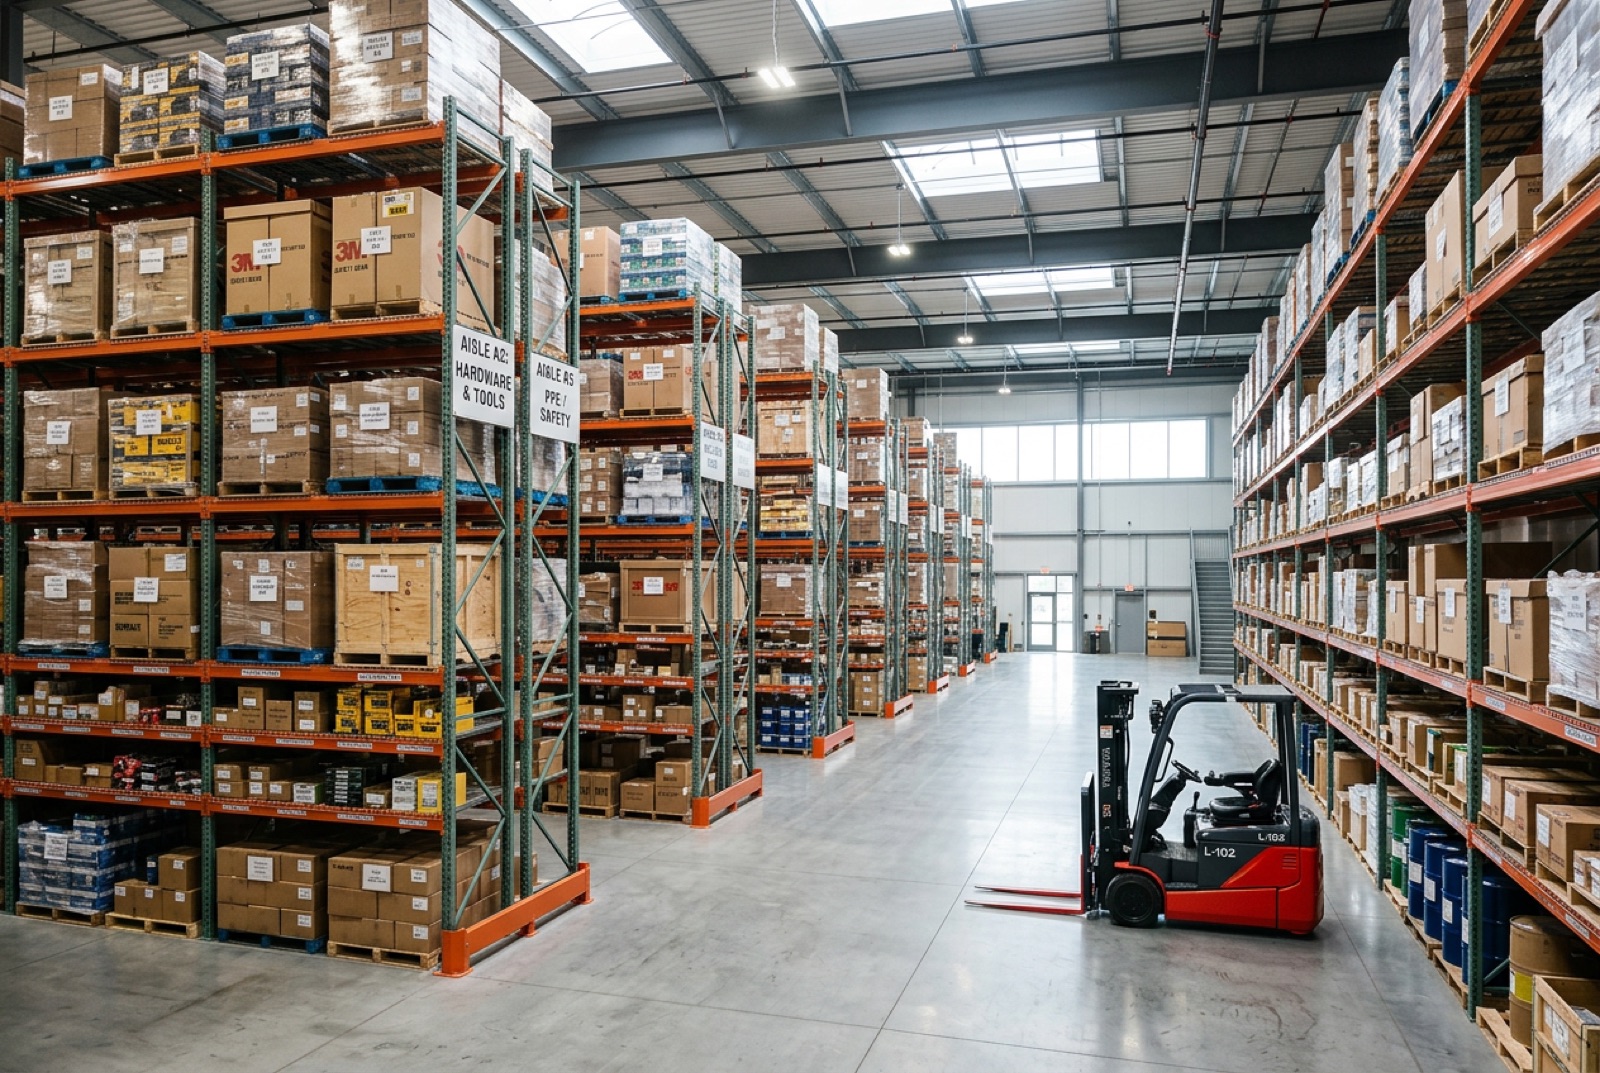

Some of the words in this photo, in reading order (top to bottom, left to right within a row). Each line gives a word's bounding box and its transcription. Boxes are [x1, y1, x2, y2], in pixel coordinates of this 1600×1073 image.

[460, 334, 491, 359] AISLE
[456, 360, 512, 391] HARDWARE
[462, 385, 471, 402] &
[473, 387, 505, 410] TOOLS
[545, 389, 561, 407] PPE
[540, 406, 571, 429] SAFETY
[1204, 846, 1236, 858] L-102
